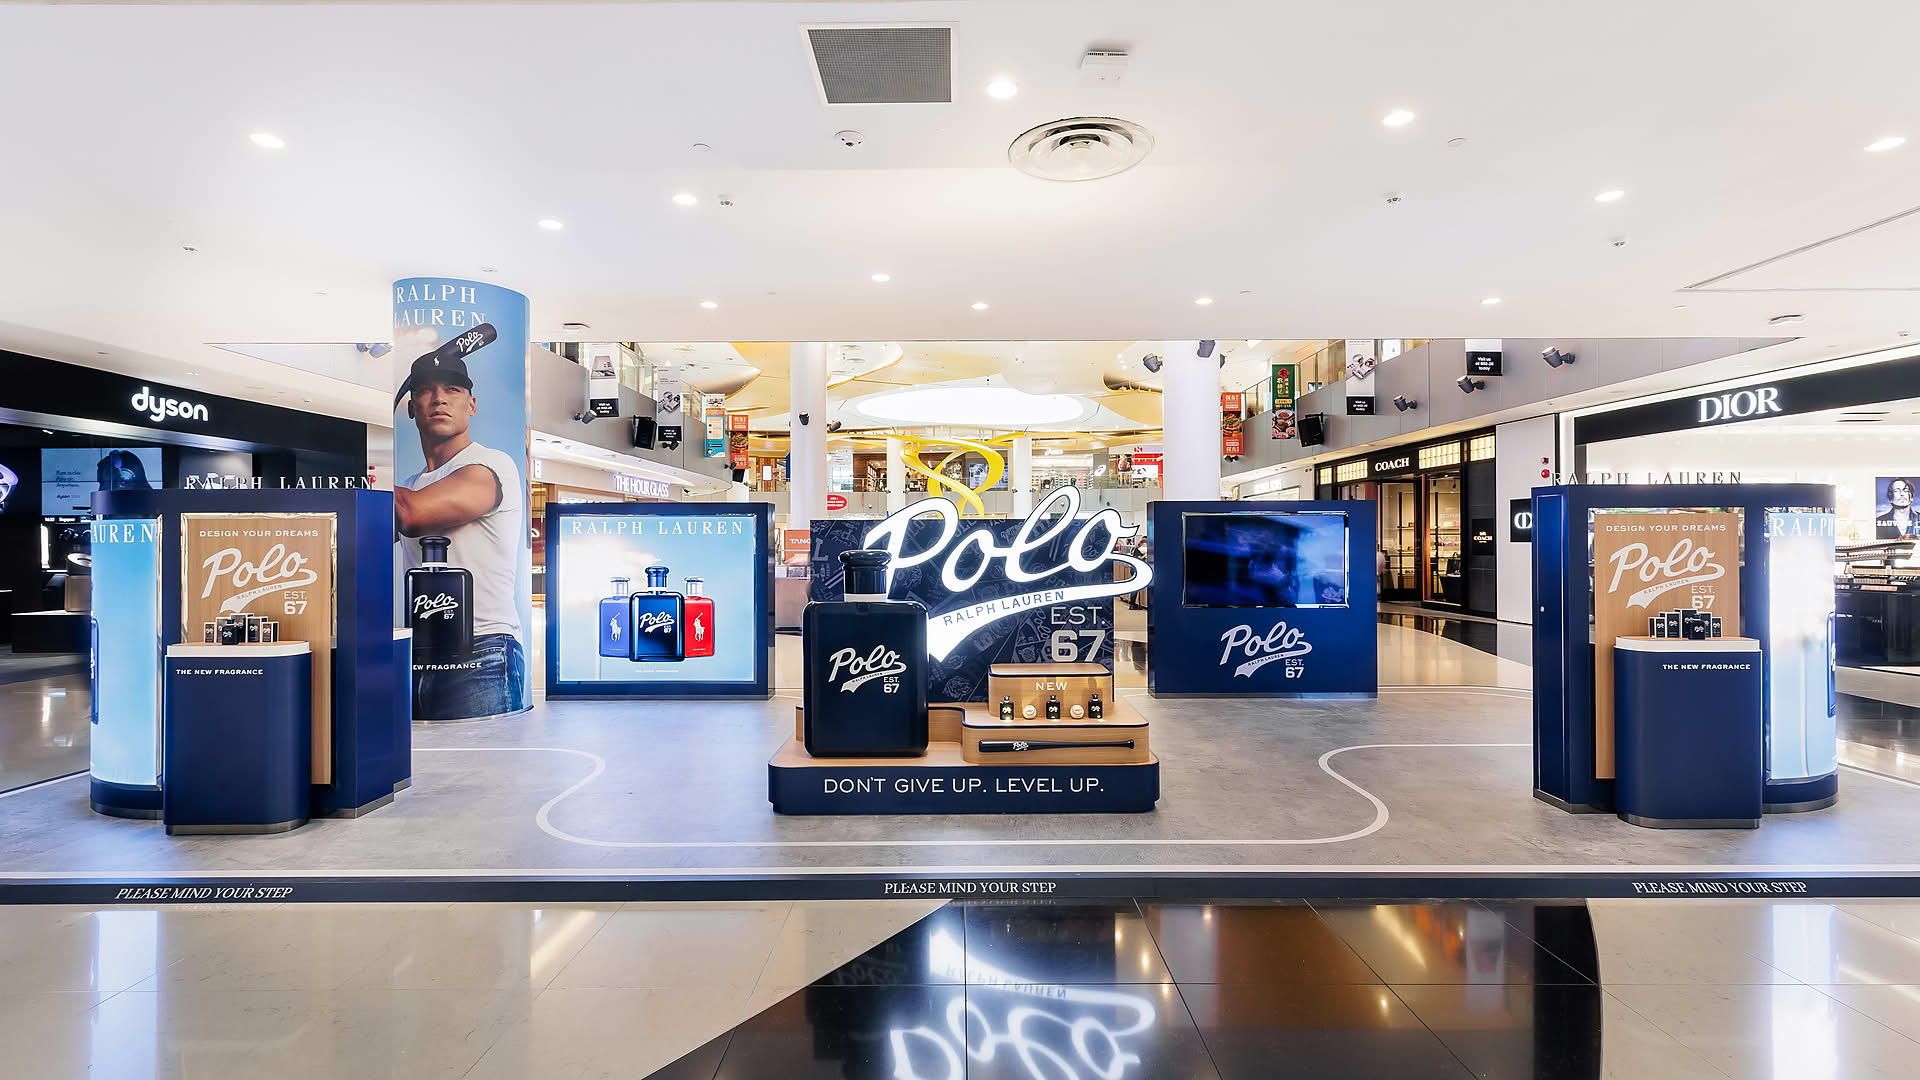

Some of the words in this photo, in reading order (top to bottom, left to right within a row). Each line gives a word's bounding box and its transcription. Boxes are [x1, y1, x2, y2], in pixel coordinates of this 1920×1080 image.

[397, 284, 476, 304] RALPH
[394, 308, 486, 329] LAUREN
[456, 331, 481, 352] Polo
[131, 386, 209, 422] dyson
[1698, 387, 1782, 423] DIOR
[1374, 457, 1410, 472] COACH
[184, 476, 263, 489] RALPH
[280, 476, 372, 489] LAUREN
[615, 475, 630, 492] THE
[630, 478, 650, 495] HOUR
[650, 482, 669, 497] GLASS
[1552, 472, 1629, 486] RALPH
[1648, 472, 1741, 485] LAUREN
[91, 523, 155, 543] AUREN
[572, 521, 642, 535] RALPH
[658, 521, 743, 535] LAUREN
[1772, 517, 1834, 537] RALPH
[863, 485, 1142, 605] Polo
[201, 543, 310, 599] Polo
[1608, 538, 1717, 593] Polo
[236, 589, 257, 600] RALPH
[257, 584, 283, 595] LAUREN
[284, 591, 308, 600] EST.
[1643, 585, 1664, 595] RALPH
[1664, 579, 1690, 589] LAUREN
[1691, 585, 1715, 594] EST.
[284, 601, 308, 615] 67
[413, 592, 456, 614] Polo
[943, 604, 996, 627] RALPH
[1002, 591, 1065, 610] LAUREN
[1691, 595, 1715, 609] 67
[640, 611, 673, 629] Polo
[1051, 606, 1106, 625] EST.
[1051, 629, 1106, 662] 67
[1220, 621, 1305, 665] Polo
[426, 662, 482, 671] FRAGRANCE
[828, 644, 901, 682] Polo
[1285, 666, 1305, 679] 67
[883, 683, 900, 693] 67
[1035, 681, 1068, 691] NEW
[824, 776, 887, 793] DON'T
[894, 777, 945, 793] GIVE
[952, 777, 987, 793] UP.
[996, 777, 1063, 793] LEVEL
[1070, 777, 1105, 793] UP.
[114, 888, 172, 900] PLEASE
[171, 887, 212, 899] MIND
[213, 887, 255, 899] YOUR
[255, 887, 294, 899] STEP
[884, 882, 936, 895] PLEASE
[938, 882, 977, 893] MIND
[980, 882, 1019, 893] YOUR
[1022, 882, 1057, 893] STEP
[1632, 882, 1689, 894] PLEASE
[1687, 882, 1729, 893] MIND
[1728, 882, 1772, 893] YOUR
[1770, 881, 1807, 893] STEP
